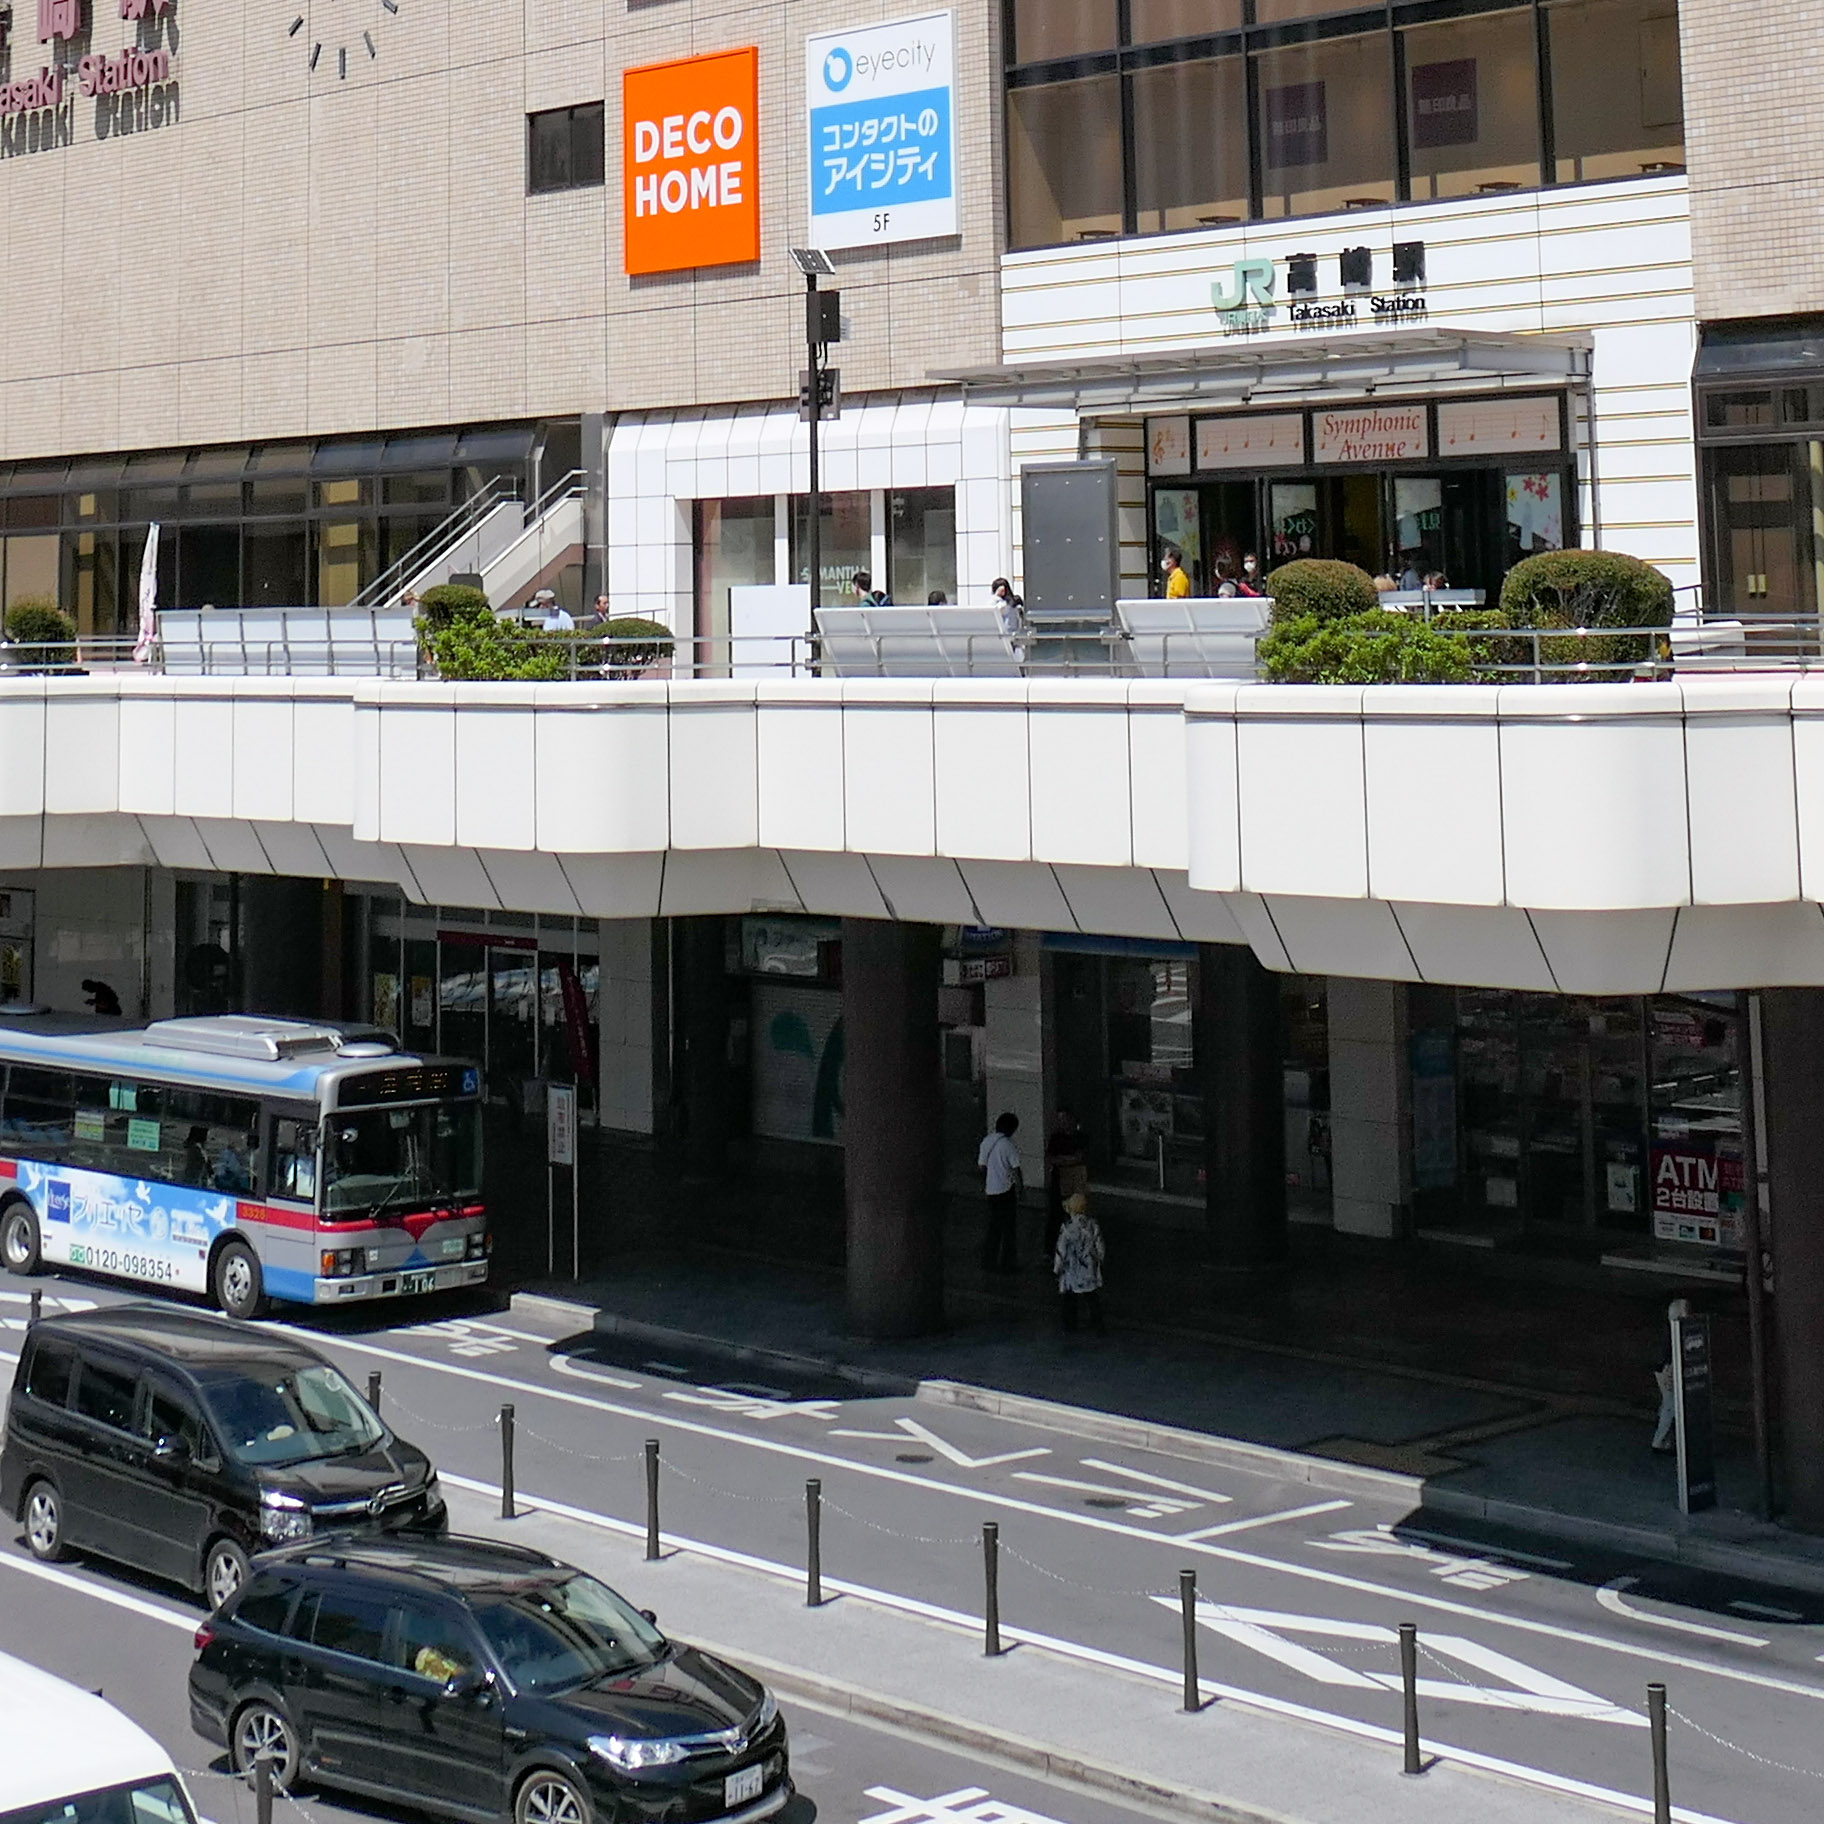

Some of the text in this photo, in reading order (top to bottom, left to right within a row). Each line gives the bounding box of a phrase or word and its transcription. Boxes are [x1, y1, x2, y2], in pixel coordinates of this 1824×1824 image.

[78, 47, 170, 98] Station
[856, 39, 937, 86] eyecity
[634, 105, 743, 164] DECO
[822, 107, 939, 153] コンタクトの
[634, 161, 743, 218] HOME
[823, 148, 939, 196] アイシティ
[873, 213, 891, 233] 5F
[1210, 257, 1277, 311] JR
[1287, 292, 1427, 322] Takasaki Station
[1322, 408, 1421, 440] Symphonic
[1337, 438, 1407, 461] Avenue
[800, 564, 870, 580] SMANTHA
[1656, 1153, 1719, 1191] ATM
[86, 1246, 173, 1280] 0120-098354
